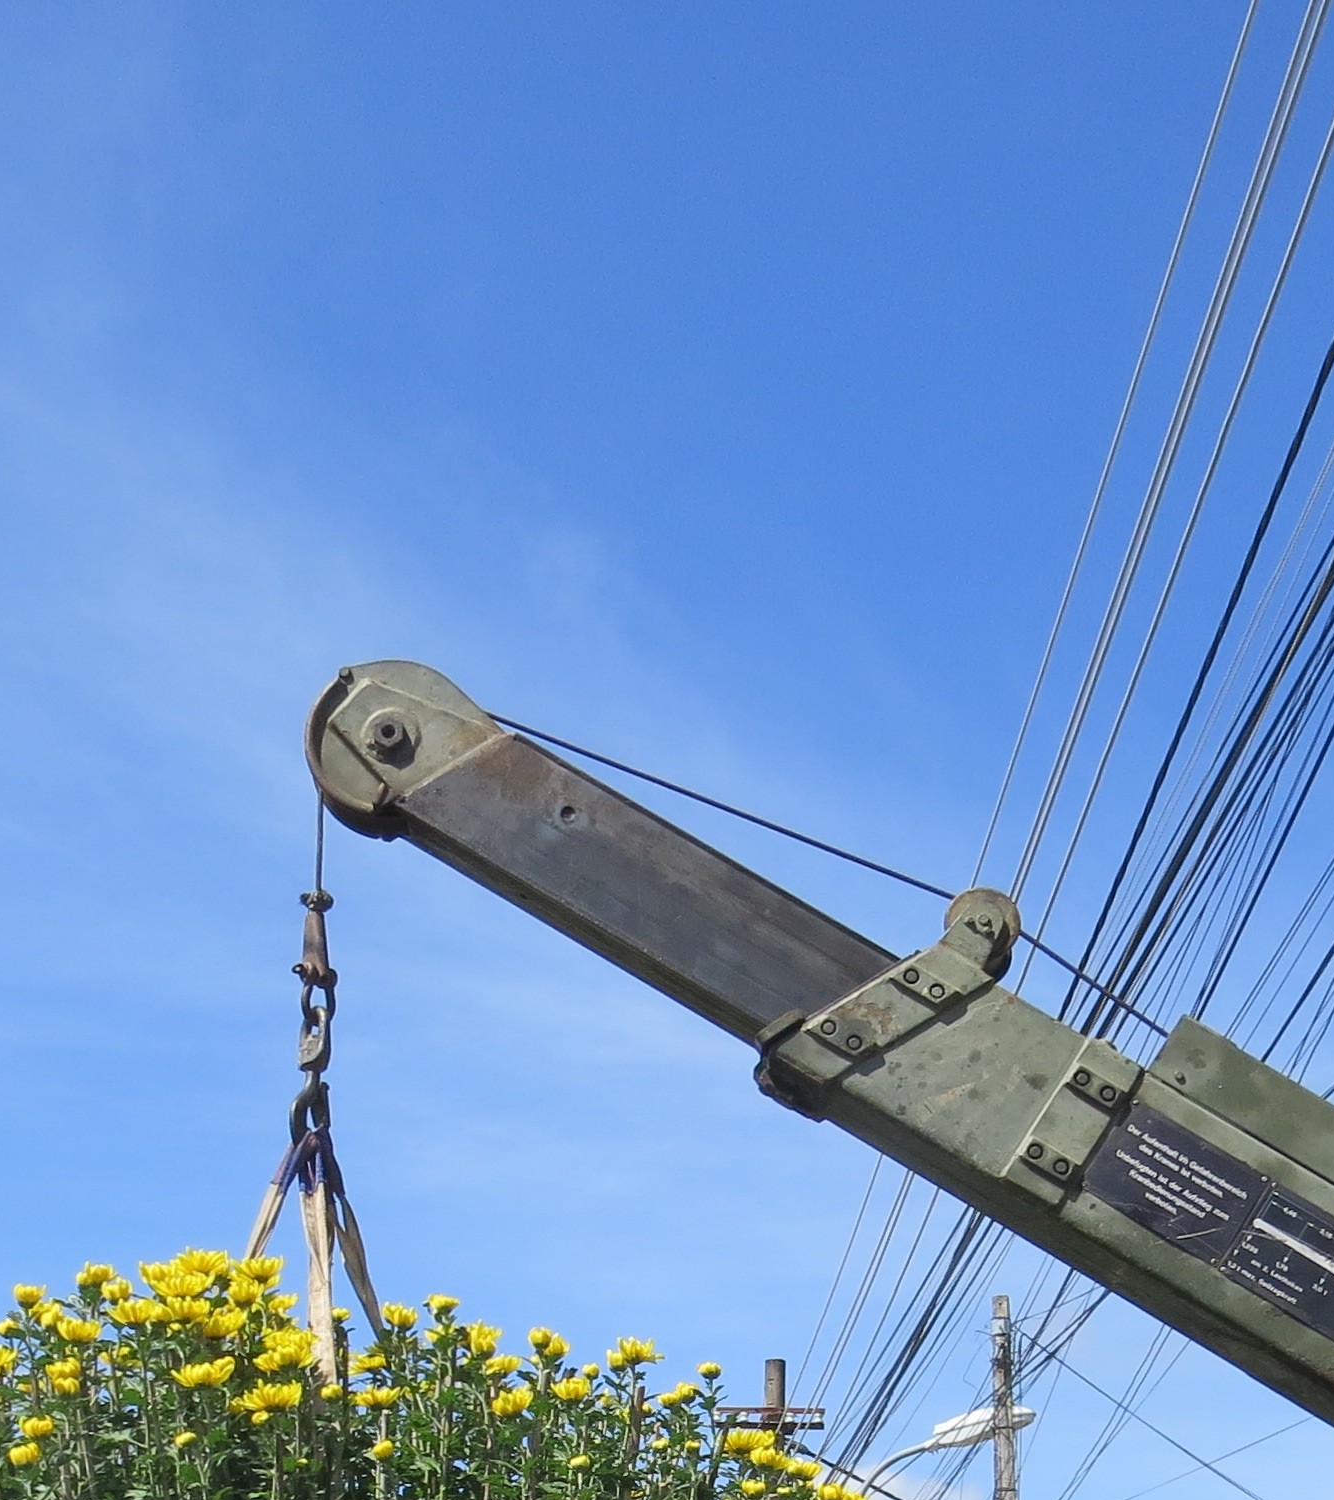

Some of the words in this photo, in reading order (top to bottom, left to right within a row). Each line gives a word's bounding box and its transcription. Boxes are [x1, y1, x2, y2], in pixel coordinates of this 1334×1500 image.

[1116, 1149, 1157, 1178] Unbefugten
[1157, 1174, 1169, 1185] ist
[1168, 1182, 1183, 1192] der
[1182, 1189, 1213, 1212] Aufstieg
[1212, 1208, 1230, 1221] zum
[1127, 1124, 1142, 1136] Der
[1141, 1133, 1179, 1159] Aufenthalt
[1189, 1161, 1247, 1200] Gefahrenbereich
[1138, 1144, 1153, 1156] des
[1153, 1152, 1180, 1171] Kranes
[1180, 1167, 1191, 1178] ist
[1191, 1175, 1223, 1198] verboten.
[1128, 1169, 1206, 1218] Kranbedienungsstand
[1145, 1192, 1177, 1215] verboten.
